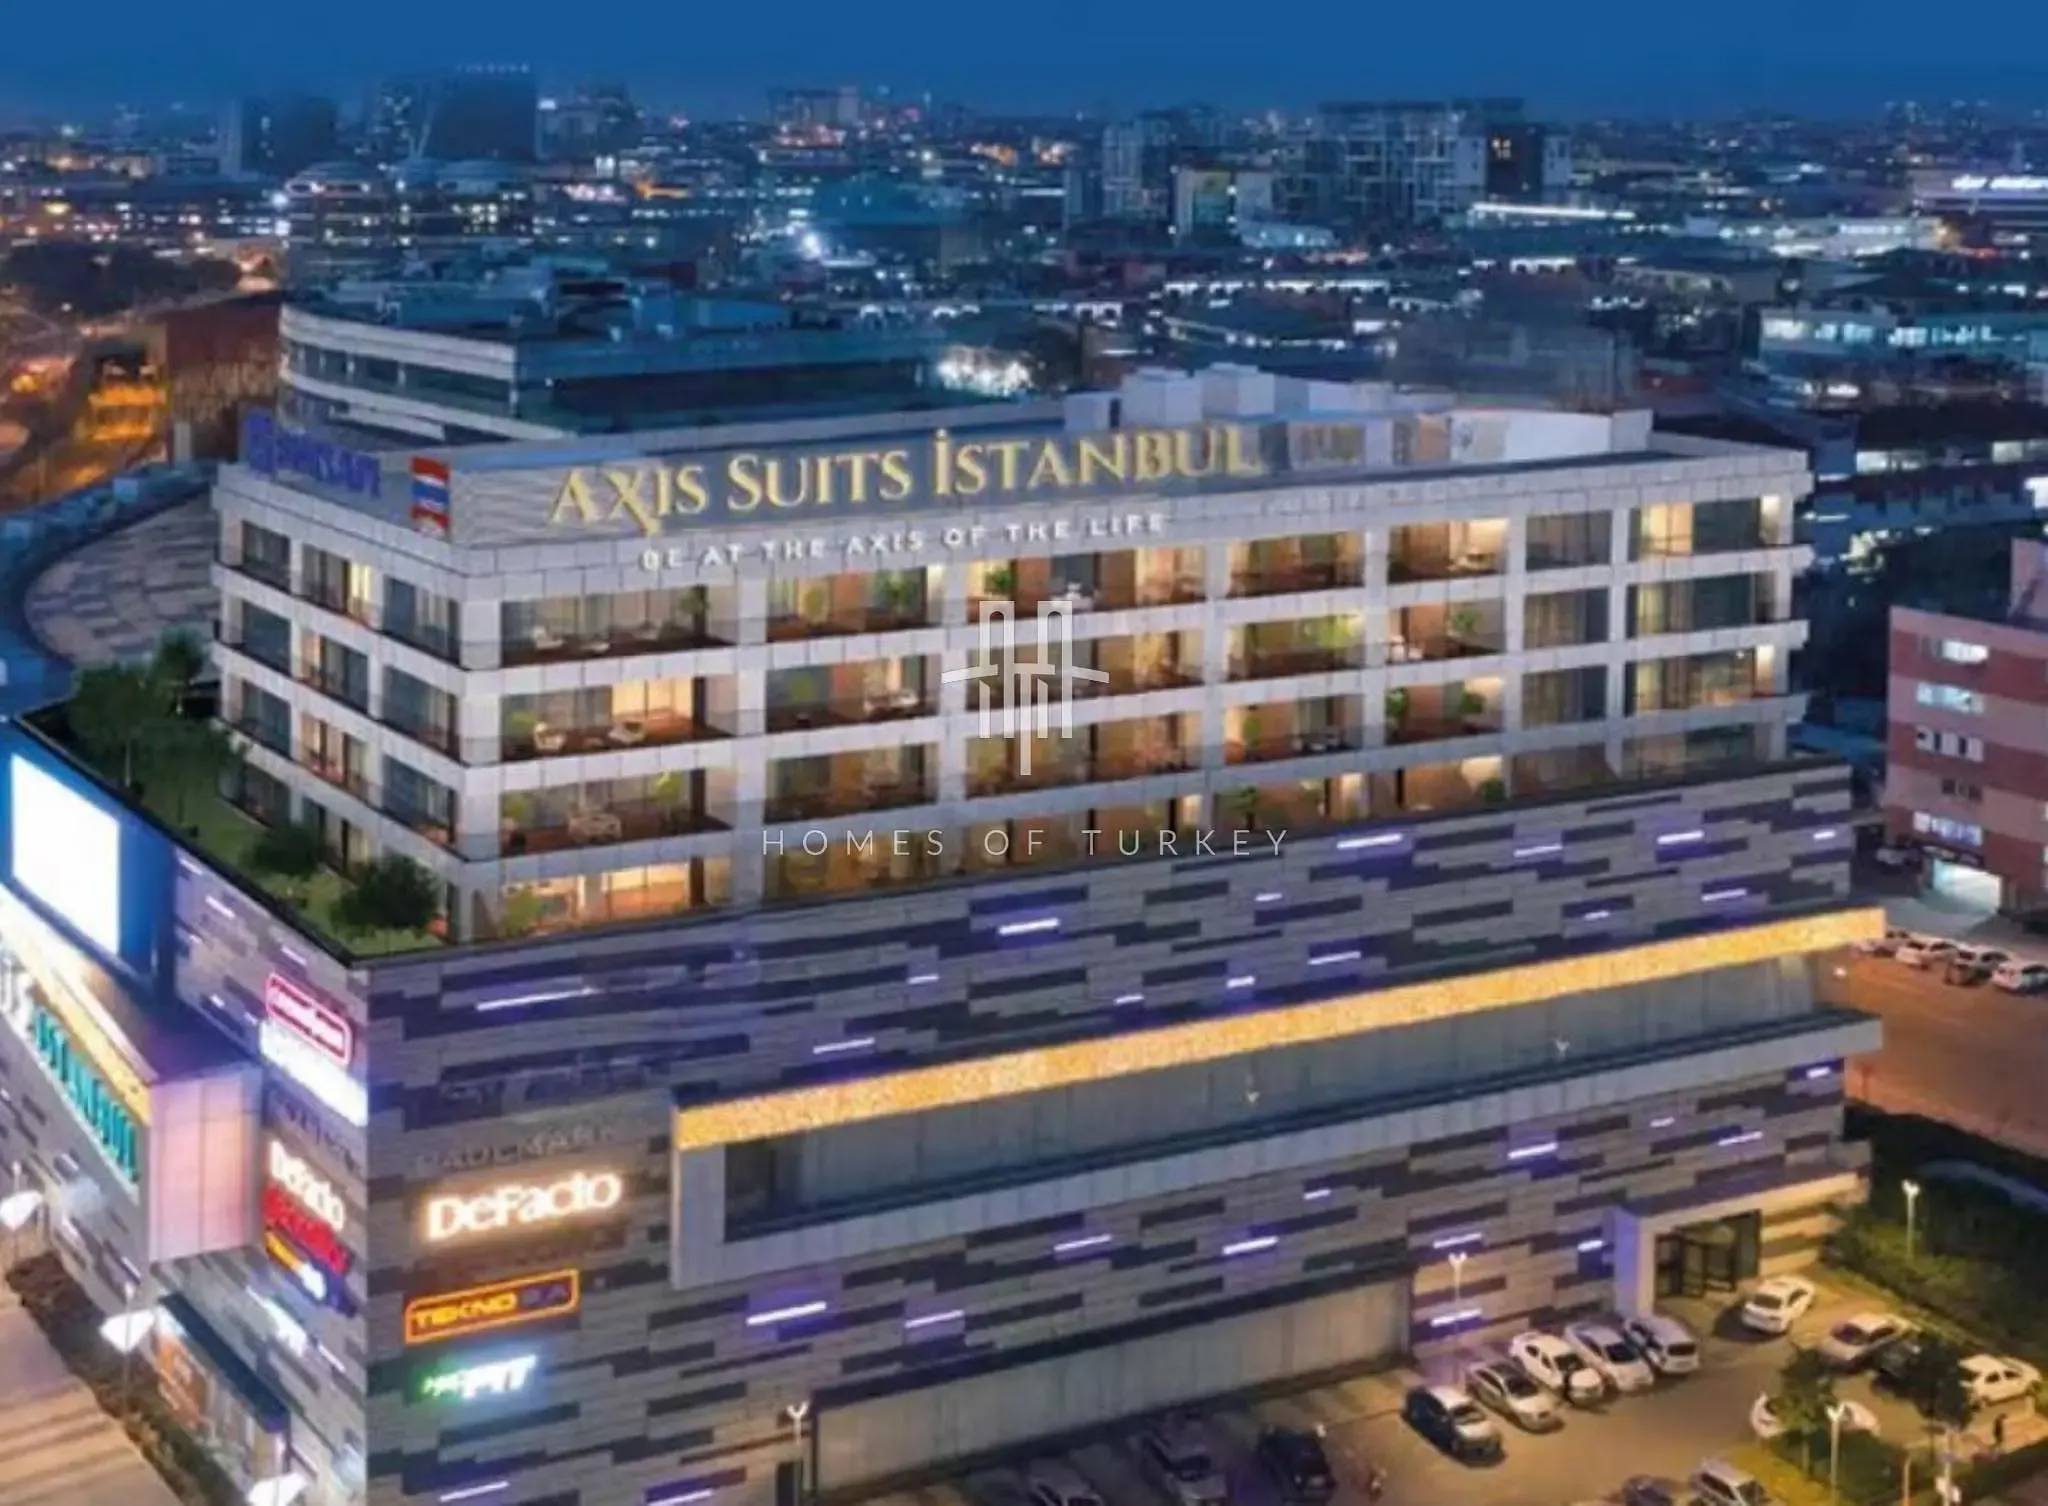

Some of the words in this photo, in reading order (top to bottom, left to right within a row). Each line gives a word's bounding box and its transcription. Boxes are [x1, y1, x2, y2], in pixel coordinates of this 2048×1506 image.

[552, 463, 709, 535] AXIS
[726, 450, 913, 511] SUITS
[933, 427, 1268, 496] İSTANBUL
[703, 543, 743, 566] AT
[761, 538, 825, 561] THE
[848, 530, 925, 556] AXIS
[945, 527, 987, 546] OF
[1004, 520, 1070, 541] THE
[1089, 512, 1164, 536] LIFE
[427, 1171, 621, 1241] DeFacto
